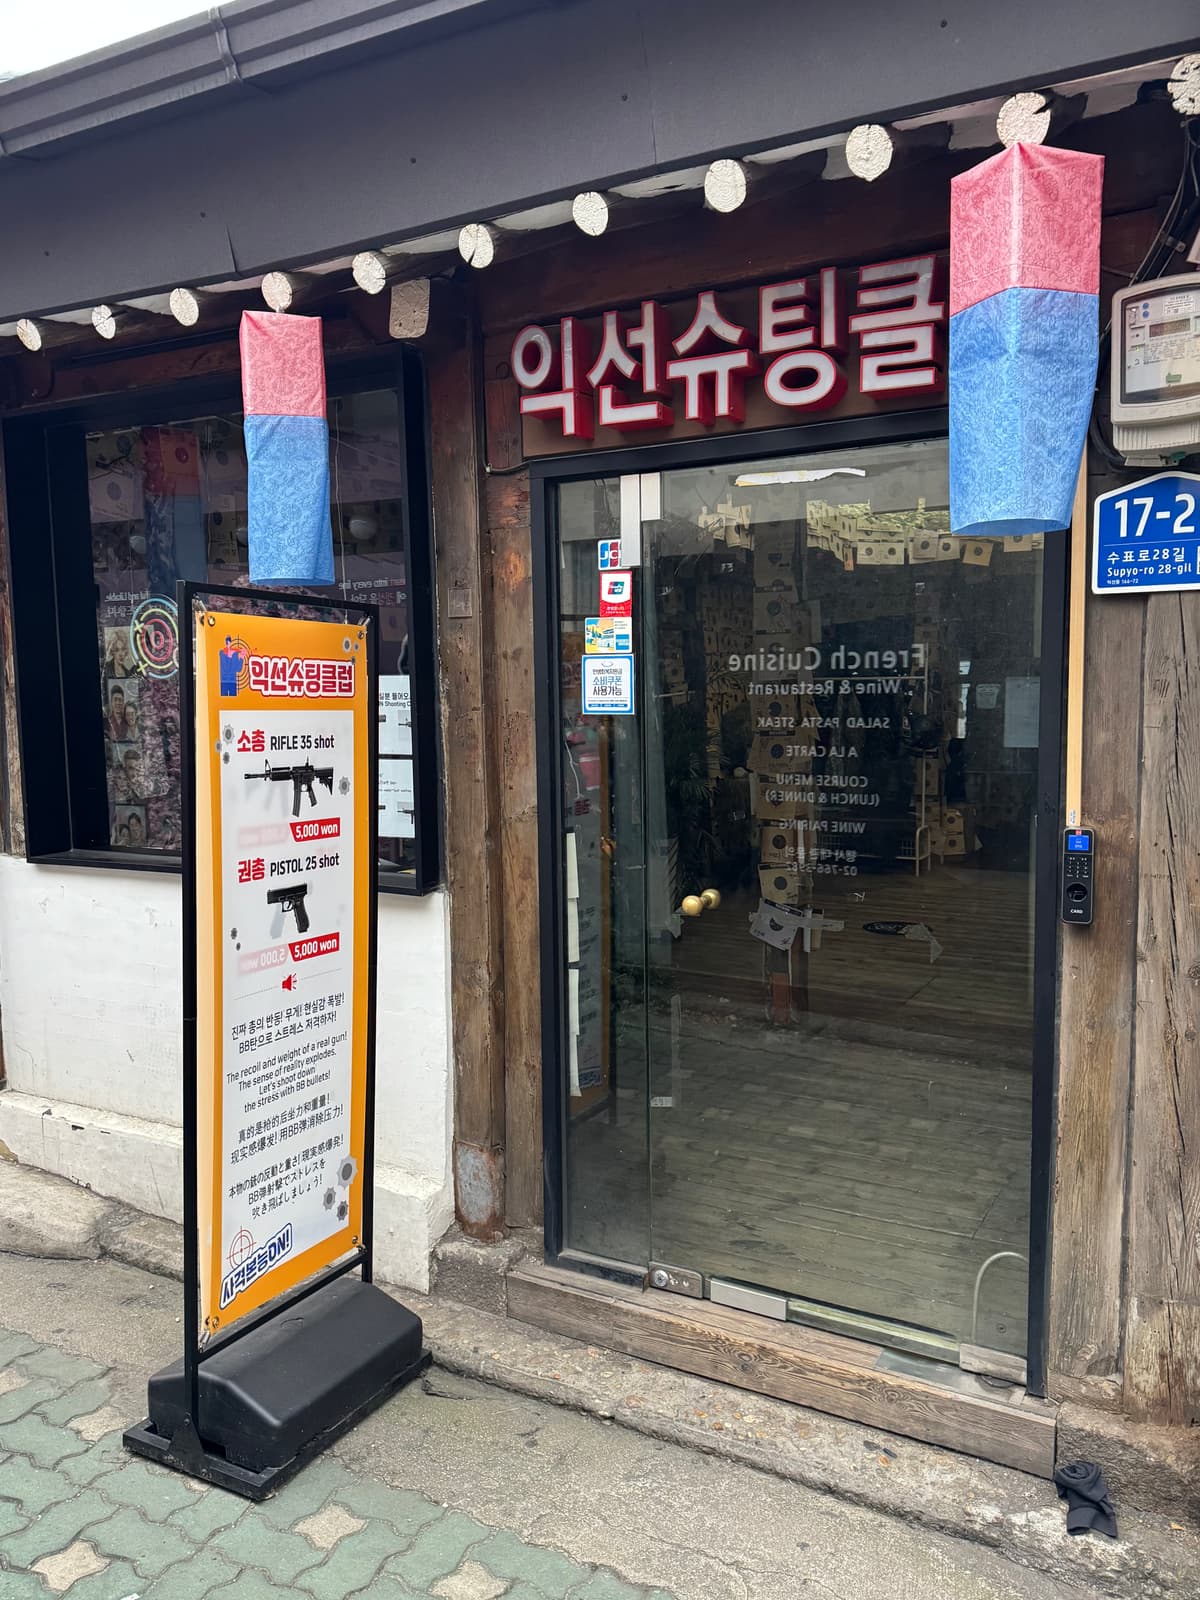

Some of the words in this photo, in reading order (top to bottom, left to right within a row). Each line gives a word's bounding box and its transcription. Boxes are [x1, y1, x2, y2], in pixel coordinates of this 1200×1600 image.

[1115, 494, 1195, 537] 17-2
[1107, 547, 1185, 565] 수표로28길
[1107, 566, 1154, 577] Supyo-ro
[1158, 563, 1192, 575] 28-gil
[250, 657, 354, 696] 익선슈팅클럽
[592, 676, 623, 686] 소비쿠폰
[592, 686, 623, 696] 사용가능
[237, 729, 266, 752] 소총
[270, 735, 298, 750] RIFLE
[300, 735, 312, 750] 35
[314, 734, 335, 748] shot
[296, 823, 319, 840] 5,000
[320, 824, 338, 836] won
[238, 858, 266, 884] 권총
[270, 861, 304, 877] PISTOL
[306, 856, 317, 871] 25
[319, 852, 340, 869] shot
[294, 940, 318, 958] 5,000
[320, 938, 338, 949] won
[304, 997, 326, 1016] 현실감
[239, 1032, 273, 1054] BB탄으로
[274, 1022, 304, 1042] 스트레스
[306, 1010, 337, 1030] 저격하자!
[226, 1071, 240, 1084] The
[240, 1062, 261, 1079] recoil
[262, 1056, 277, 1070] and
[277, 1046, 301, 1064] weight
[302, 1042, 310, 1056] of
[311, 1042, 316, 1052] a
[316, 1037, 330, 1050] real
[331, 1030, 348, 1046] gun!
[238, 1078, 252, 1092] The
[252, 1070, 274, 1086] sense
[274, 1064, 283, 1078] of
[283, 1058, 304, 1075] reality
[305, 1048, 337, 1066] explodes.
[244, 1101, 256, 1114] the
[257, 1092, 280, 1109] stress
[280, 1084, 295, 1099] with
[296, 1080, 306, 1091] BB
[306, 1069, 332, 1088] bullets!
[258, 1080, 276, 1095] Let's
[277, 1074, 296, 1088] shoot
[297, 1066, 316, 1080] down
